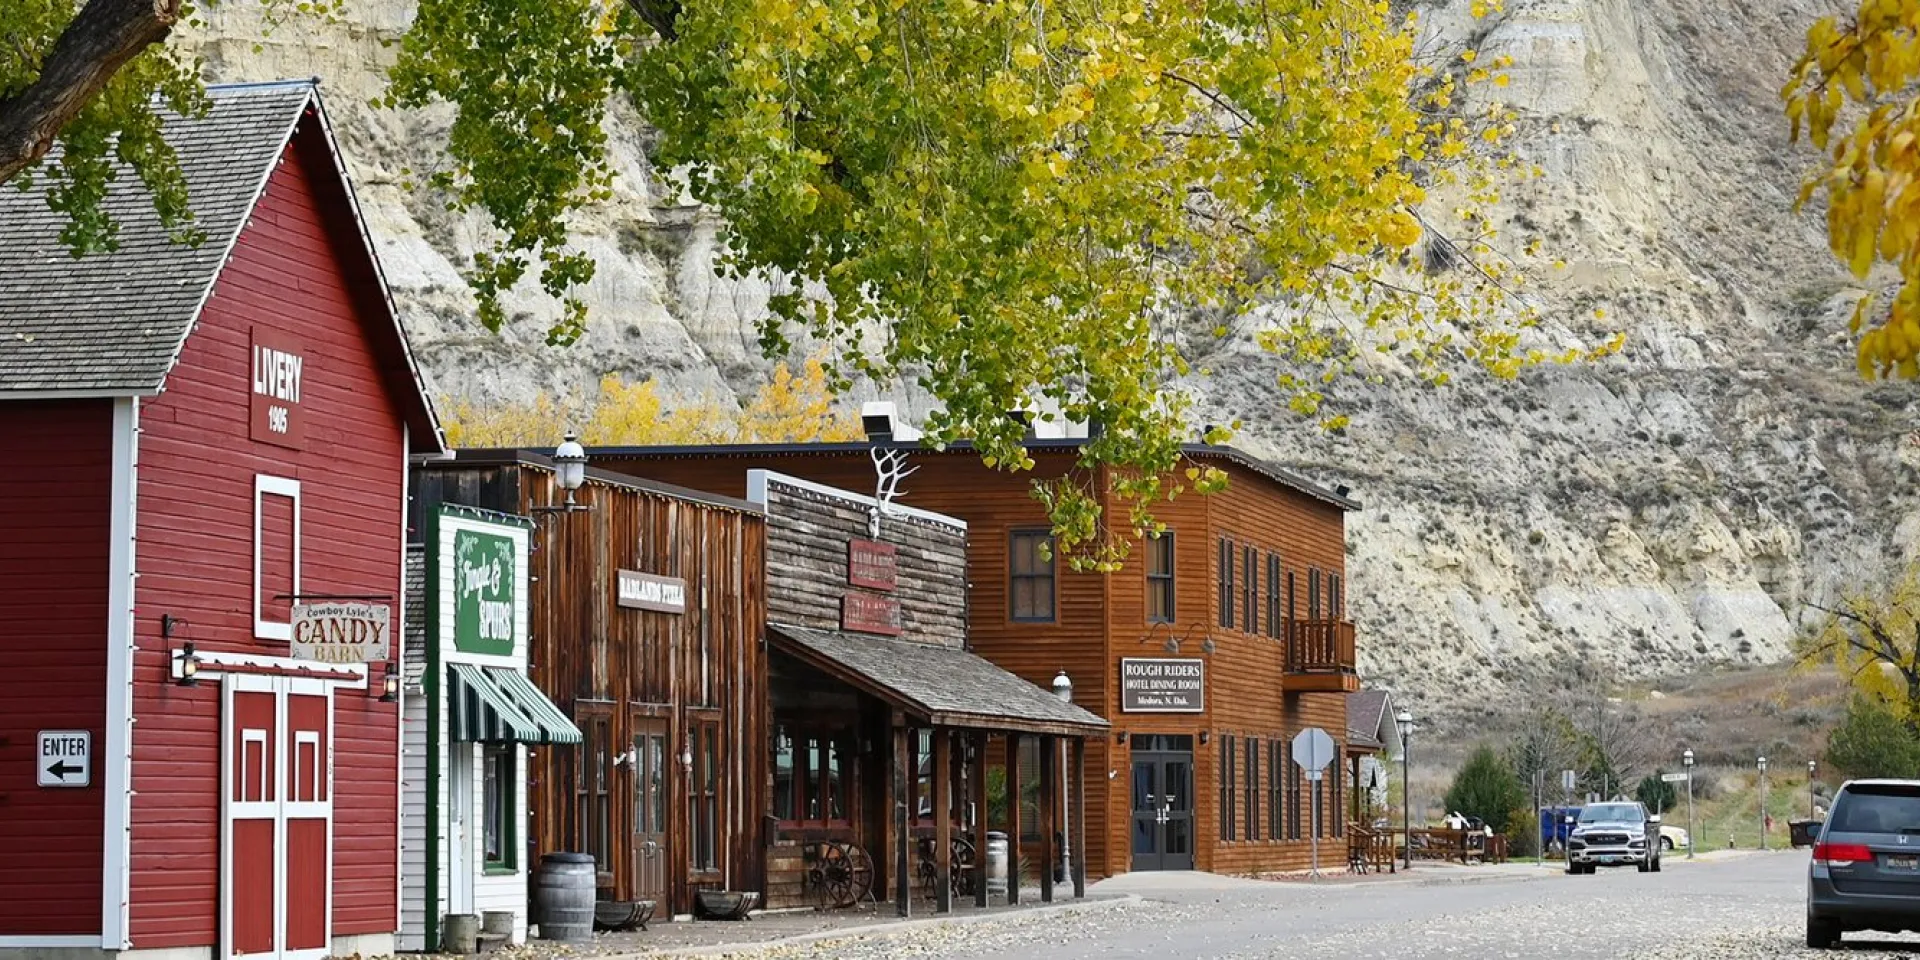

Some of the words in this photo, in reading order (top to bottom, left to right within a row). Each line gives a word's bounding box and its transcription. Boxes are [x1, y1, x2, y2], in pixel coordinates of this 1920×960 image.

[254, 345, 303, 404] LIVERY
[269, 405, 288, 434] 1905
[491, 558, 502, 596] &
[619, 577, 661, 603] BADLANDS
[307, 607, 343, 618] Cowboy
[346, 607, 374, 618] Lyle's
[479, 600, 512, 640] SPURS
[294, 618, 385, 644] CANDY
[314, 645, 364, 663] BARN
[1126, 664, 1162, 677] ROUGH
[1164, 665, 1200, 677] RIDERS
[1126, 679, 1149, 690] HOTEL
[1150, 680, 1177, 690] DINING
[1178, 680, 1200, 690] ROOM
[43, 738, 85, 756] ENTER
